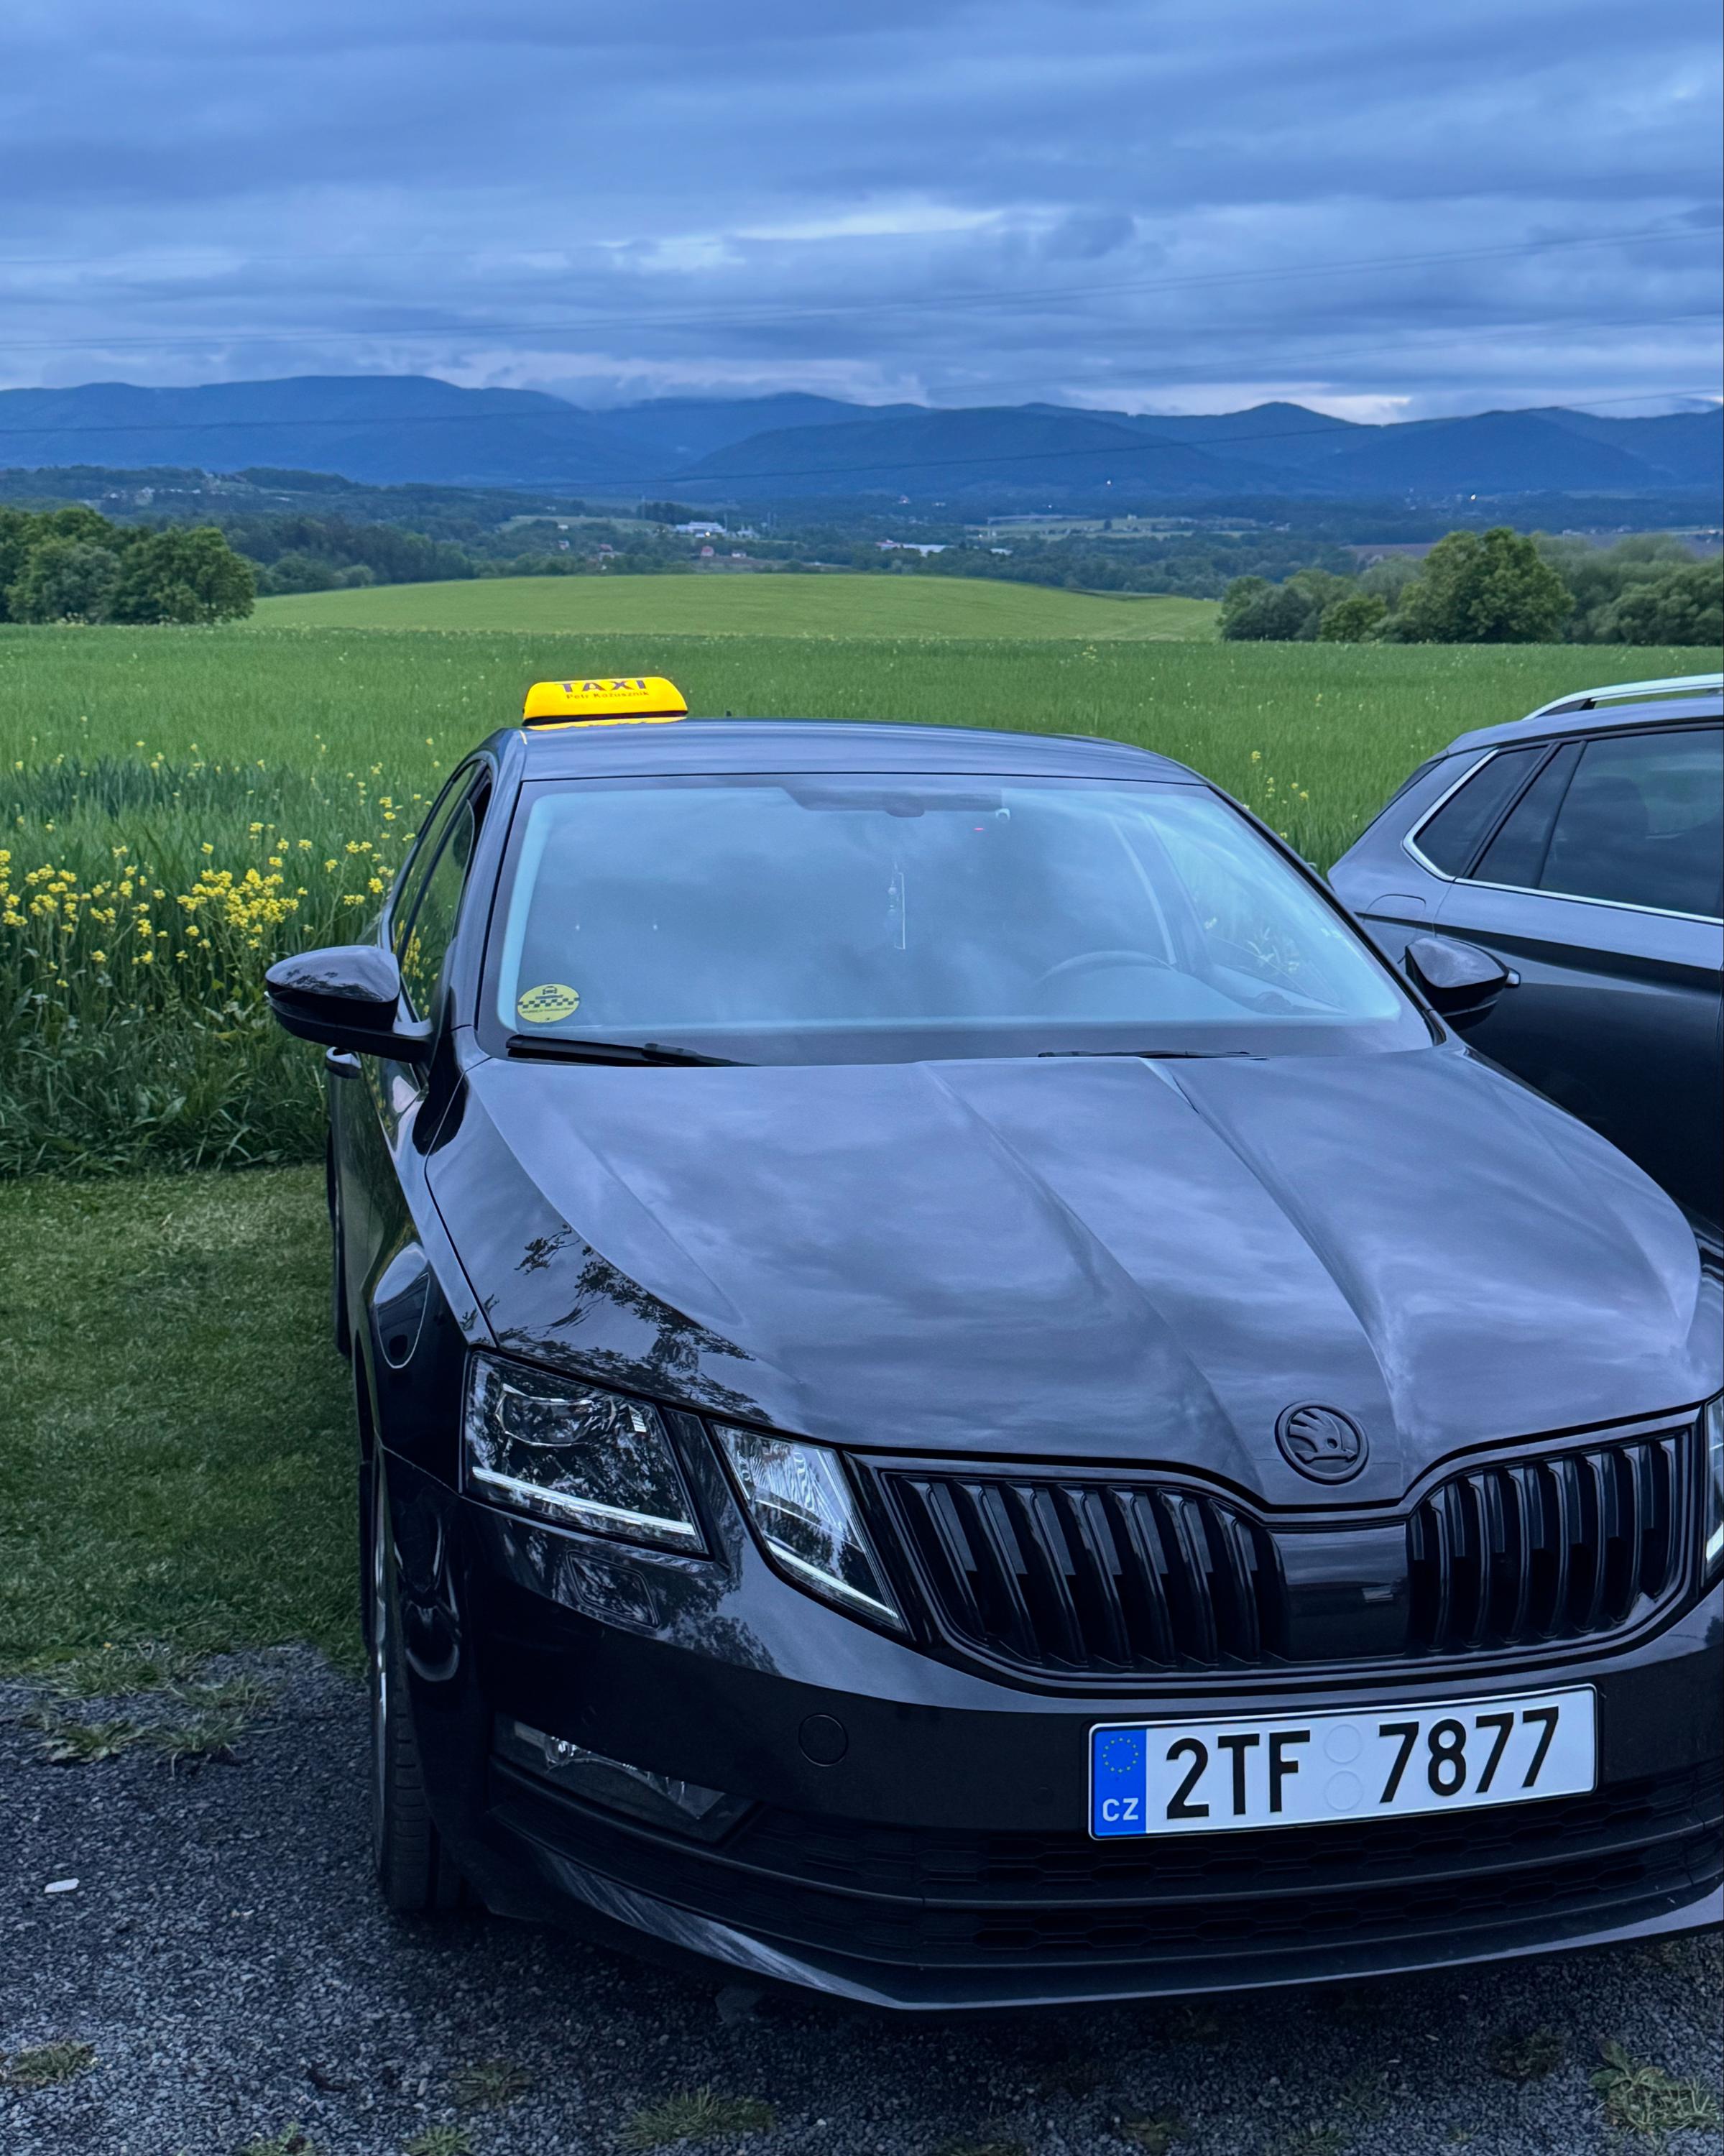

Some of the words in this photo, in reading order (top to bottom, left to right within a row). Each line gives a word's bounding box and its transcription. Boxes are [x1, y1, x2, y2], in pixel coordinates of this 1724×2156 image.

[555, 680, 647, 693] TAXI
[1166, 1730, 1311, 1820] 2TF
[1378, 1705, 1560, 1804] 7877
[1102, 1797, 1140, 1822] CZ
